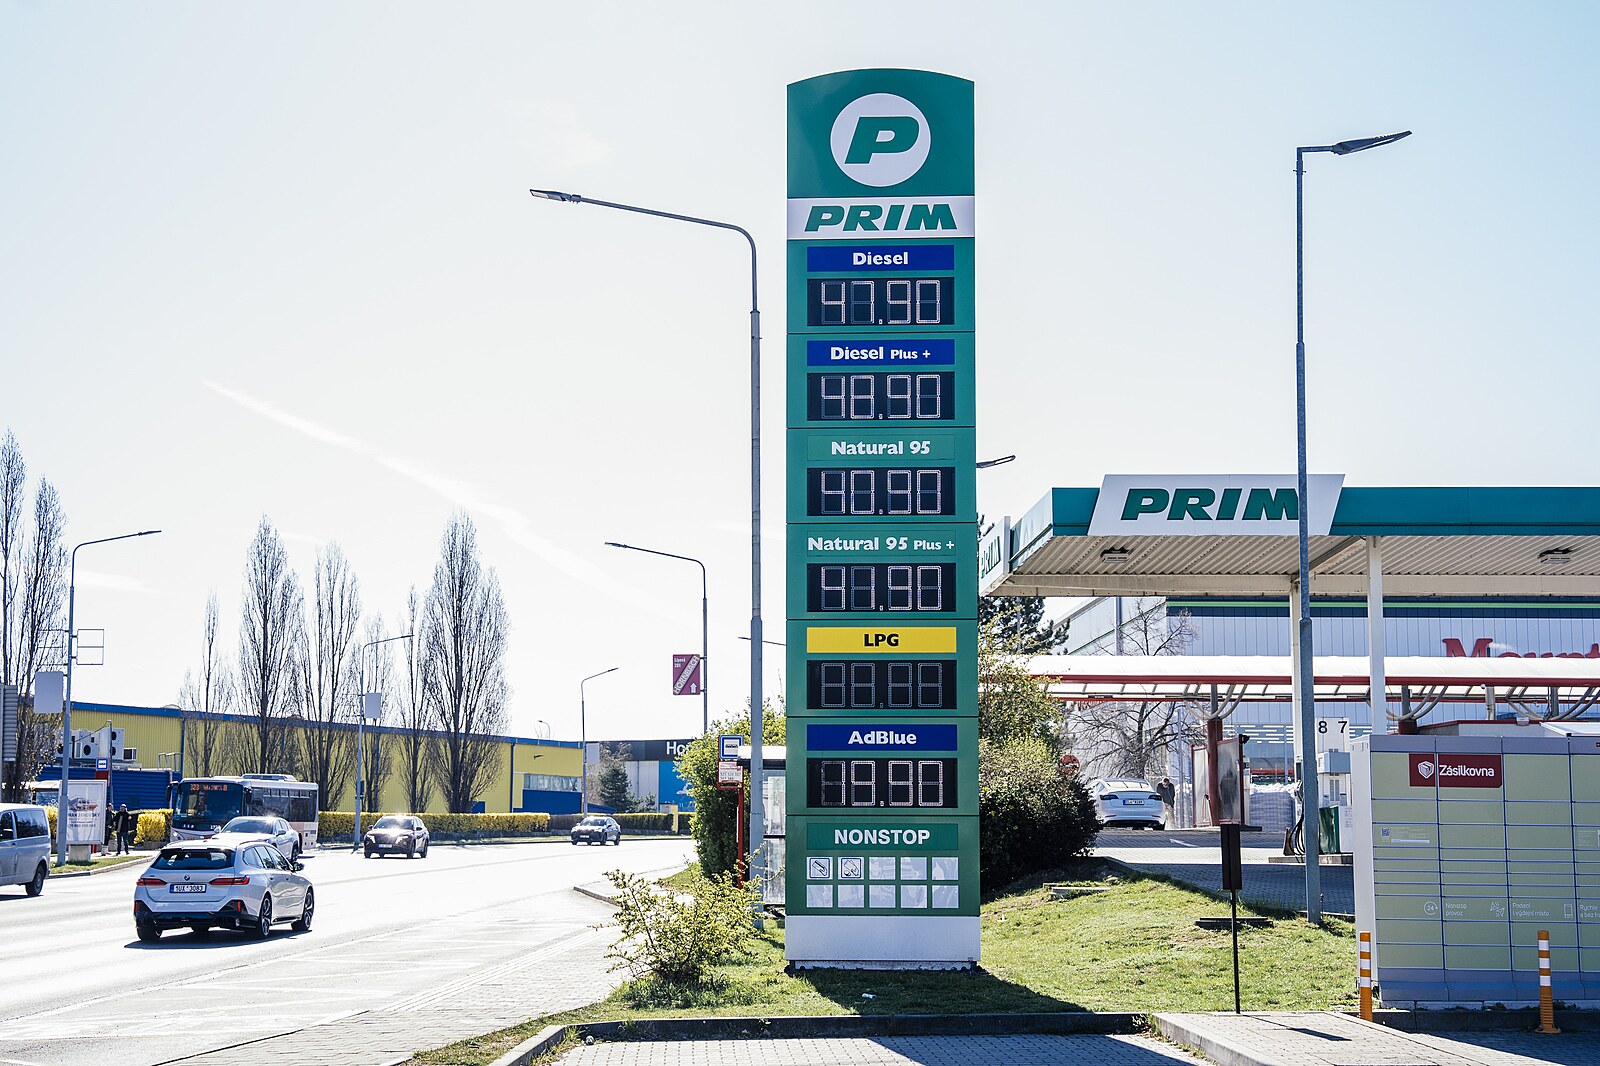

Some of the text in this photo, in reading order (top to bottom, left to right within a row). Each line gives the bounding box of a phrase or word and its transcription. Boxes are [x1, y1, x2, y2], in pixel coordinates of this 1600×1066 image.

[844, 116, 920, 164] P
[804, 203, 958, 232] PRIM
[852, 252, 909, 266] Diesel
[821, 279, 941, 325] 47.90
[830, 346, 884, 360] Diesel
[890, 348, 918, 360] Plus
[820, 374, 941, 420] 48.90
[831, 440, 931, 455] Natural 95
[820, 469, 941, 515] 40.90
[1120, 488, 1299, 521] PRIM
[807, 536, 879, 551] Natural
[885, 536, 908, 551] 95
[913, 539, 942, 551] Plus
[820, 565, 942, 611] 41.90
[863, 633, 900, 647] LPG
[673, 655, 700, 694] HORNBACH
[1318, 720, 1348, 734] 8 7
[847, 730, 917, 745] AdBlue
[1439, 764, 1495, 777] Zásilkovna
[834, 829, 930, 845] NONSTOP
